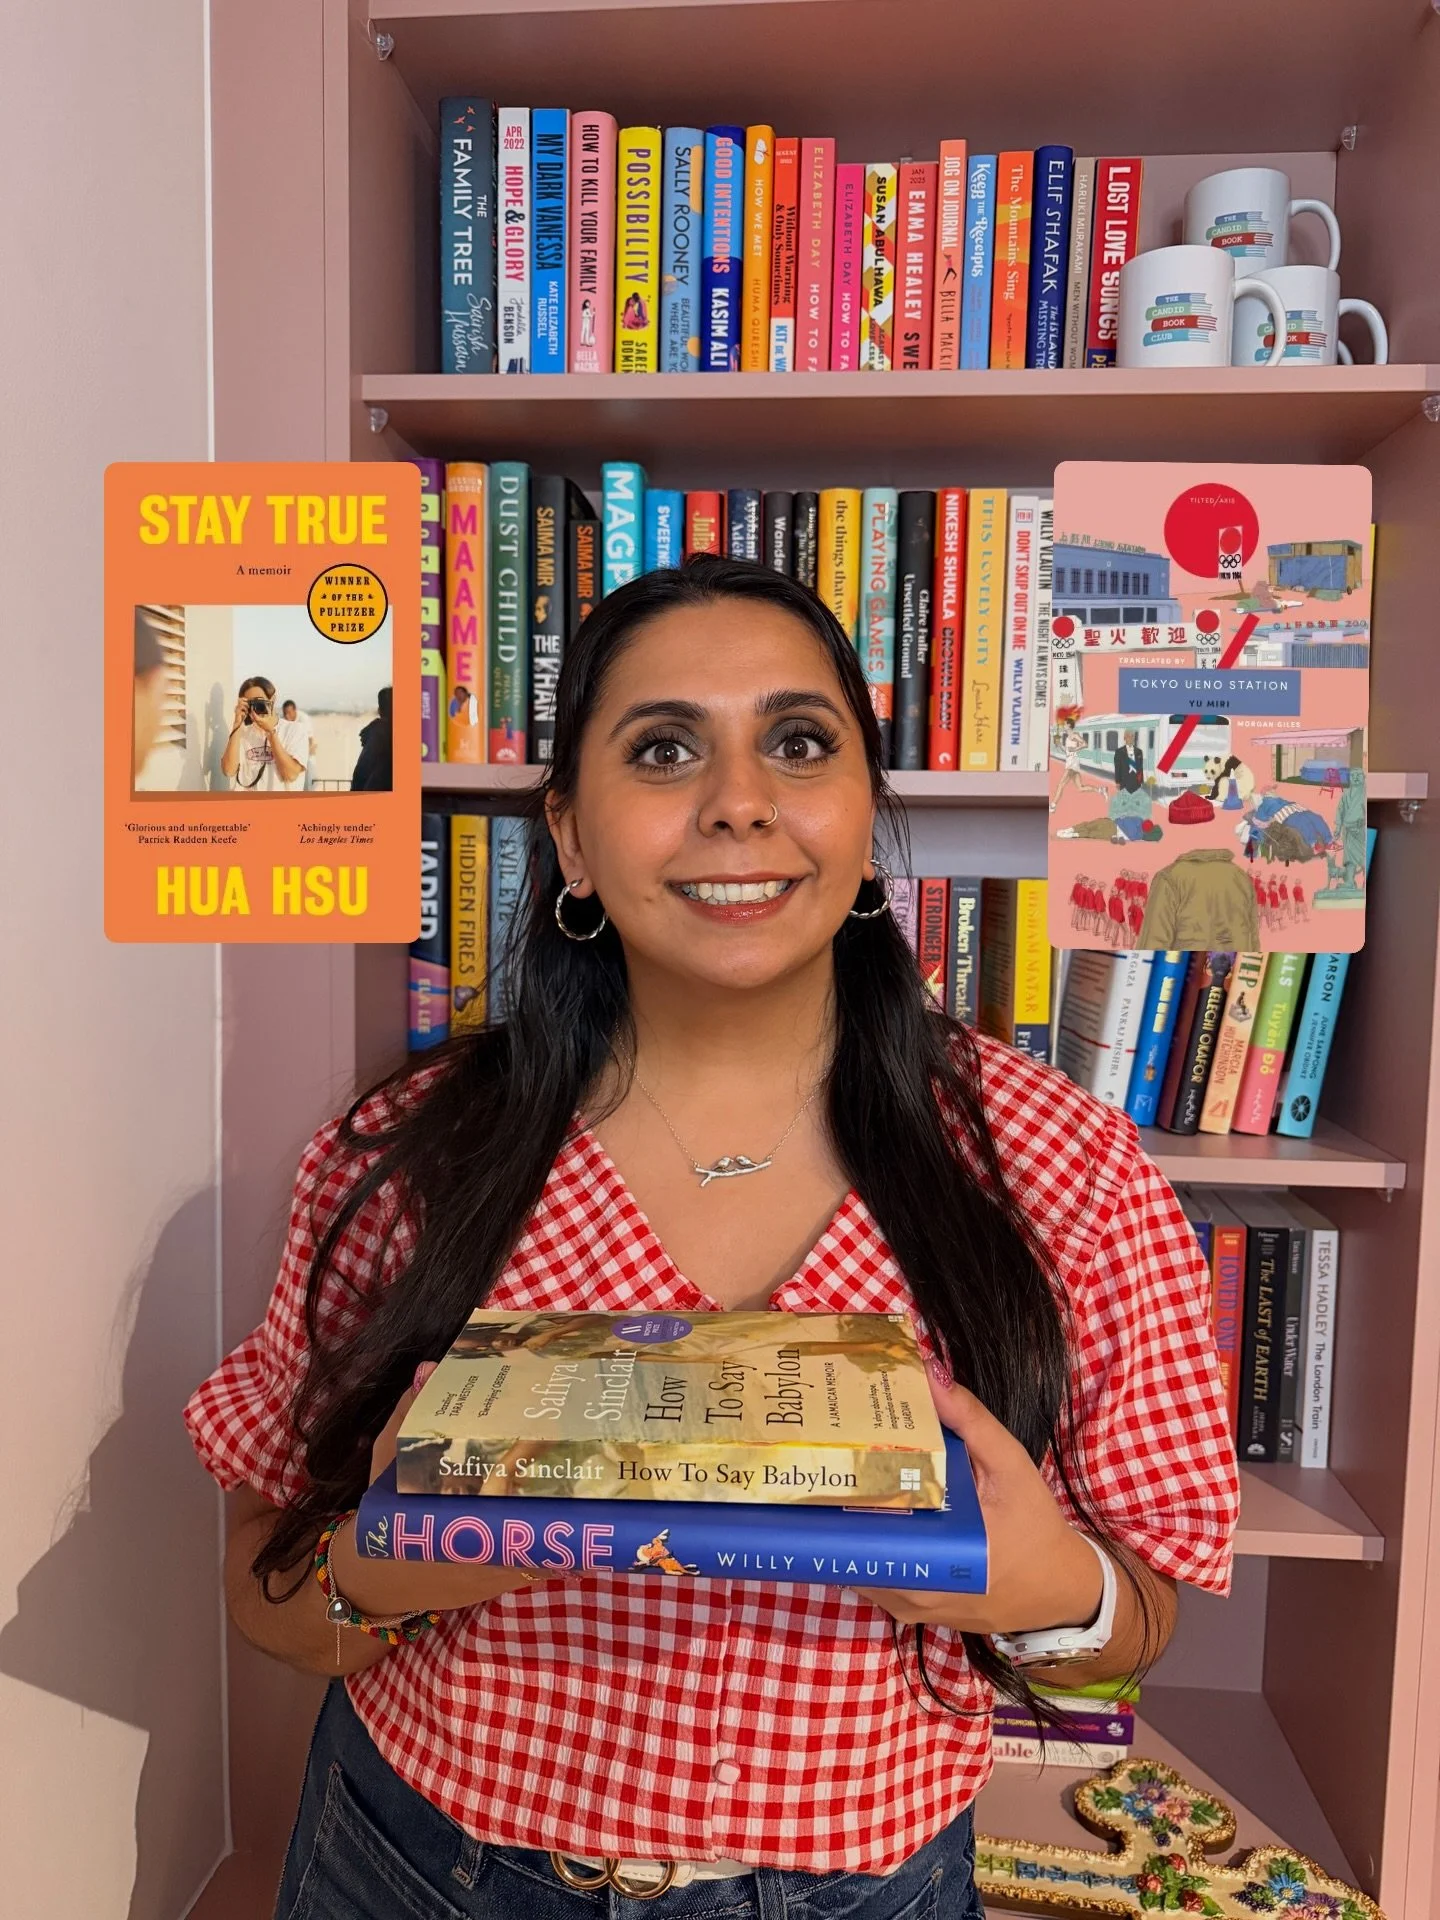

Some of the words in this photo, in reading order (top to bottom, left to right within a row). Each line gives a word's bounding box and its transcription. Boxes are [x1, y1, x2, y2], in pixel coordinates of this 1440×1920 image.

[504, 139, 524, 149] 2022
[506, 126, 522, 137] APR
[537, 134, 564, 156] MY
[582, 125, 599, 154] HOW
[582, 160, 599, 173] TO
[675, 146, 691, 200] SALLY
[714, 137, 732, 178] GOOD
[944, 156, 960, 177] JOG
[453, 139, 471, 220] FAMILY
[505, 166, 523, 207] HOPE
[537, 162, 563, 200] DARK
[581, 179, 598, 205] KILL
[755, 179, 764, 208] HOW
[811, 147, 824, 230] ELIZABETH
[944, 180, 960, 195] ON
[971, 163, 990, 199] Keep
[1010, 165, 1023, 193] The
[1048, 160, 1064, 204] ELIF
[1107, 166, 1130, 214] LOST
[476, 195, 486, 217] THE
[505, 210, 525, 224] &
[625, 148, 650, 283] POSSIBILITY
[843, 184, 853, 254] ELIZABETH
[876, 177, 886, 223] SUSAN
[907, 191, 926, 243] EMMA
[536, 204, 563, 270] VANESSA
[580, 212, 598, 244] YOUR
[712, 184, 732, 273] INTENTIONS
[754, 212, 763, 230] WE
[942, 198, 960, 250] JOURNAL
[1008, 198, 1022, 264] Mountains
[1211, 225, 1242, 236] CANDID
[1222, 235, 1242, 245] BOOK
[453, 226, 472, 285] TREE
[505, 226, 524, 282] GLORY
[673, 205, 690, 286] ROONEY
[753, 234, 762, 257] MET
[810, 240, 821, 268] DAY
[969, 218, 987, 278] Receipts
[1042, 208, 1062, 293] SHAFAK
[1104, 223, 1126, 265] LOVE
[580, 250, 597, 293] FAMILY
[842, 262, 852, 284] DAY
[873, 229, 885, 308] ABULHAWA
[905, 252, 923, 320] HEALEY
[1003, 271, 1019, 300] Sing
[548, 281, 558, 304] KATE
[711, 287, 729, 337] KASIM
[808, 284, 819, 319] HOW
[841, 293, 850, 324] HOW
[1097, 272, 1119, 341] SONGS
[1152, 306, 1184, 316] CANDID
[504, 306, 514, 343] BENSON
[538, 298, 547, 338] RUSSELL
[548, 308, 557, 355] ELIZABETH
[1036, 300, 1048, 346] MISSING
[1163, 319, 1185, 327] BOOK
[710, 343, 728, 366] ALI
[808, 329, 818, 349] TO
[840, 331, 849, 347] TO
[499, 476, 519, 557] DUST
[537, 507, 555, 555] SAIMA
[836, 500, 848, 524] the
[945, 494, 959, 553] NIKESH
[577, 525, 593, 569] SAIMA
[833, 529, 847, 570] things
[870, 503, 886, 592] PLAYING
[1016, 531, 1030, 561] DON'T
[536, 559, 554, 586] MIR
[577, 573, 593, 598] MIR
[833, 574, 845, 601] that
[942, 556, 957, 621] SHUKLA
[1015, 565, 1029, 590] SKIP
[451, 504, 478, 682] MAAME
[903, 573, 916, 631] Unsettled
[1013, 592, 1028, 614] OUT
[497, 568, 518, 663] CHILD
[868, 598, 885, 673] GAMES
[1013, 617, 1027, 631] ON
[901, 632, 913, 679] Ground
[1012, 636, 1026, 650] ME
[1012, 658, 1023, 694] WILLY
[1010, 696, 1022, 745] VLAUTIN
[459, 834, 476, 915] HIDDEN
[925, 887, 943, 963] STRONGER
[957, 897, 975, 952] Broken
[459, 920, 475, 974] FIRES
[1202, 986, 1223, 1031] KELECHI
[1319, 1016, 1328, 1036] JUNE
[1192, 1034, 1213, 1084] OKAFOR
[1212, 1026, 1234, 1085] HUTCHINSON
[1228, 1039, 1244, 1075] MARCIA
[1309, 1040, 1324, 1079] SARPONG
[1261, 1259, 1274, 1282] The
[1318, 1240, 1331, 1280] TESSA
[1218, 1256, 1239, 1311] LOVED
[1258, 1285, 1273, 1322] LAST
[1316, 1284, 1329, 1336] HADLEY
[1253, 1325, 1272, 1343] of
[1314, 1342, 1325, 1361] The
[493, 1365, 511, 1388] OBSERVER
[523, 1361, 580, 1421] Safiya
[583, 1348, 639, 1423] Sinclair
[709, 1361, 757, 1392] Say
[764, 1348, 814, 1427] Babylon
[1253, 1347, 1274, 1401] EARTH
[1312, 1364, 1324, 1403] London
[450, 1402, 462, 1417] TARA
[457, 1375, 479, 1403] WESTOVER
[644, 1375, 688, 1424] How
[704, 1398, 742, 1424] To
[828, 1387, 840, 1420] JAMAICAN
[900, 1401, 915, 1429] GUARDIAN
[1312, 1405, 1323, 1430] Train
[439, 1457, 507, 1482] Safiya
[515, 1458, 604, 1481] Sinclair
[617, 1461, 672, 1481] How
[678, 1463, 708, 1483] To
[716, 1465, 755, 1490] Say
[762, 1465, 858, 1492] Babylon
[366, 1514, 389, 1558] The
[393, 1513, 614, 1572] HORSE
[716, 1552, 794, 1570] WILLY
[813, 1558, 930, 1578] VLAUTIN
